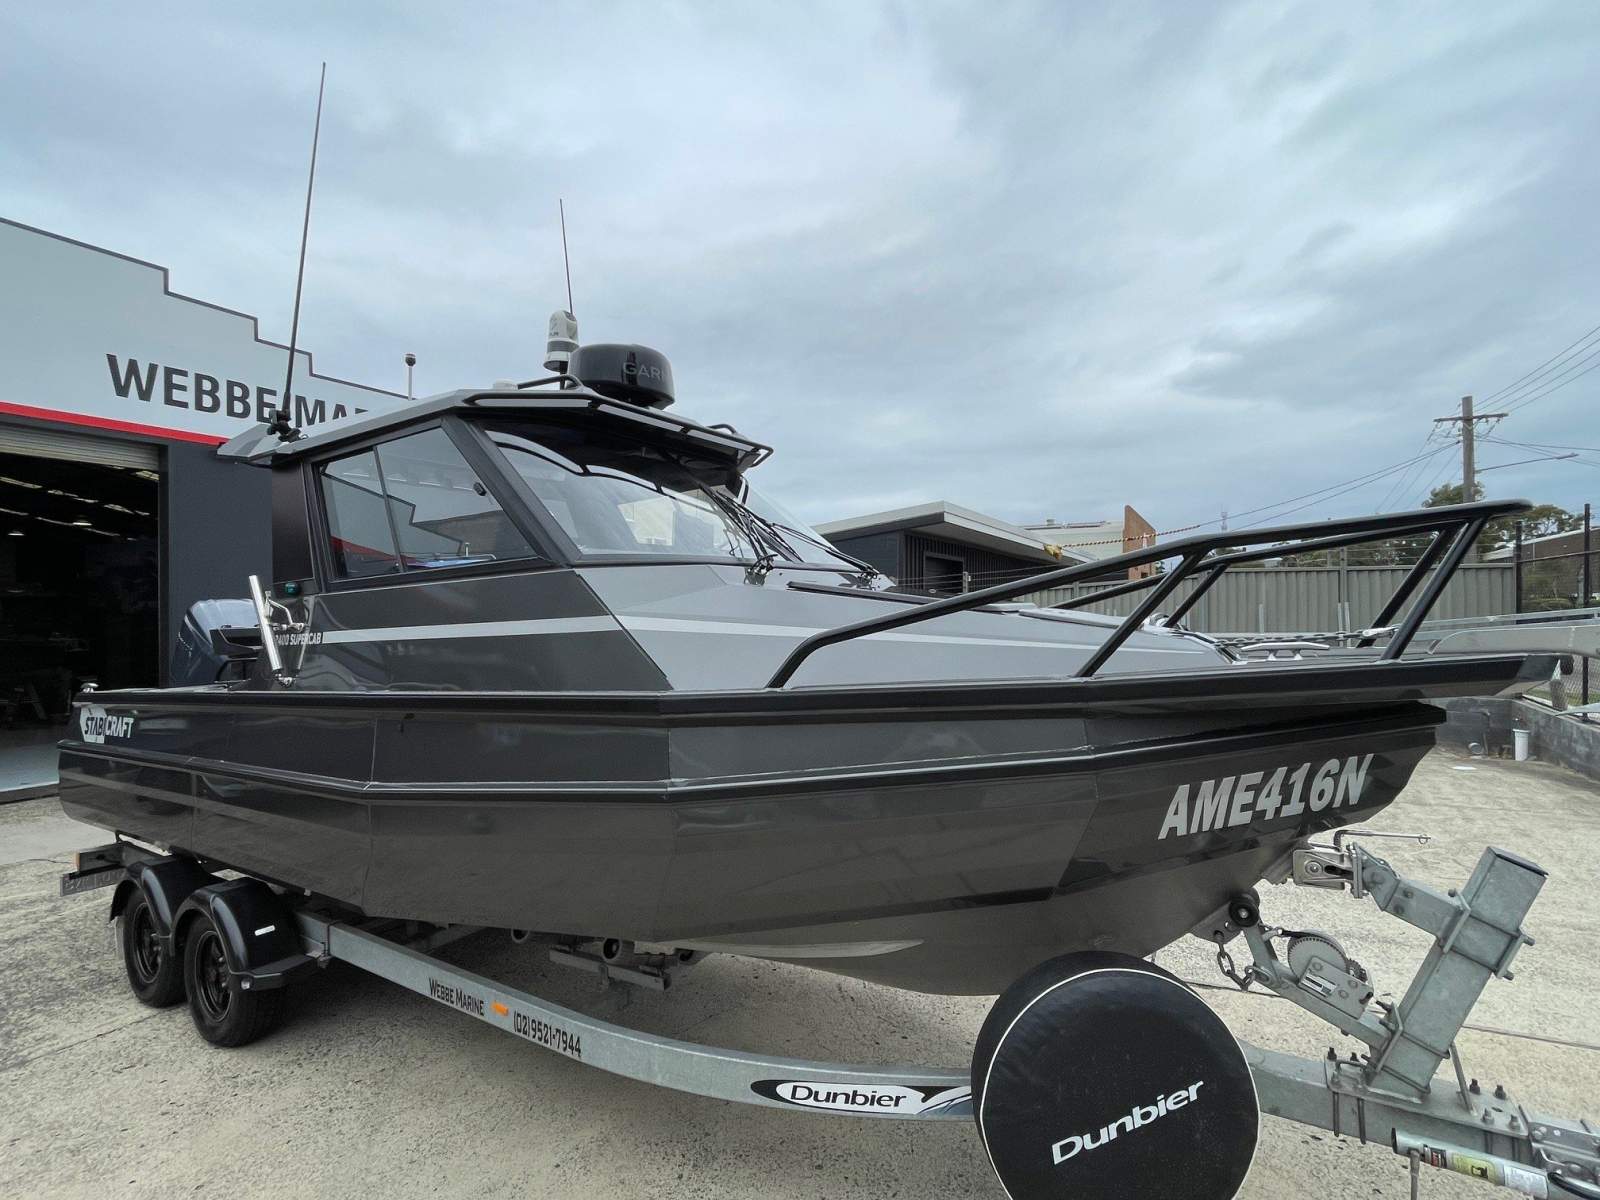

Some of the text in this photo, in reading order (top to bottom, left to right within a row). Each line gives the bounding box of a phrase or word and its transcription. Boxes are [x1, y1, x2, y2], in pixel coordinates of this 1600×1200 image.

[106, 353, 369, 428] WEBBE MA
[290, 632, 321, 646] SUPERCAB
[1157, 753, 1375, 840] AME416N
[790, 1084, 907, 1107] Dunbier
[1051, 1080, 1204, 1165] Dunbier
